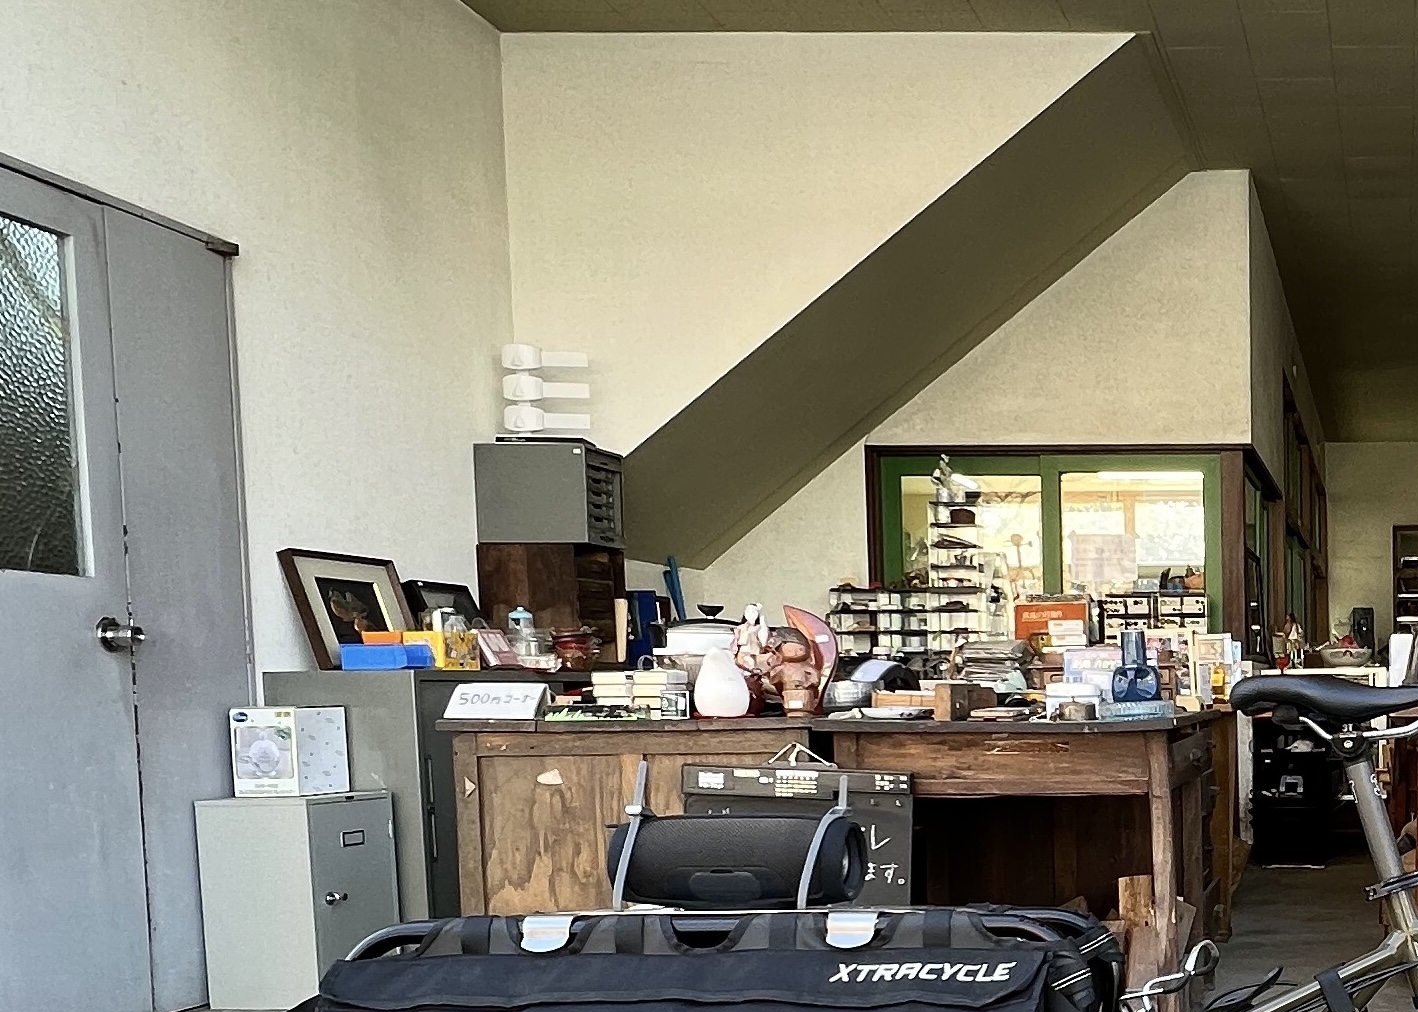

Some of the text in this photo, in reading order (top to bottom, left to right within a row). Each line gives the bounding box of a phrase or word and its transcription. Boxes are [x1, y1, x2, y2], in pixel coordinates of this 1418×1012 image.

[458, 692, 537, 706] 500円コーナー
[829, 961, 1017, 982] XTRACYCLE
